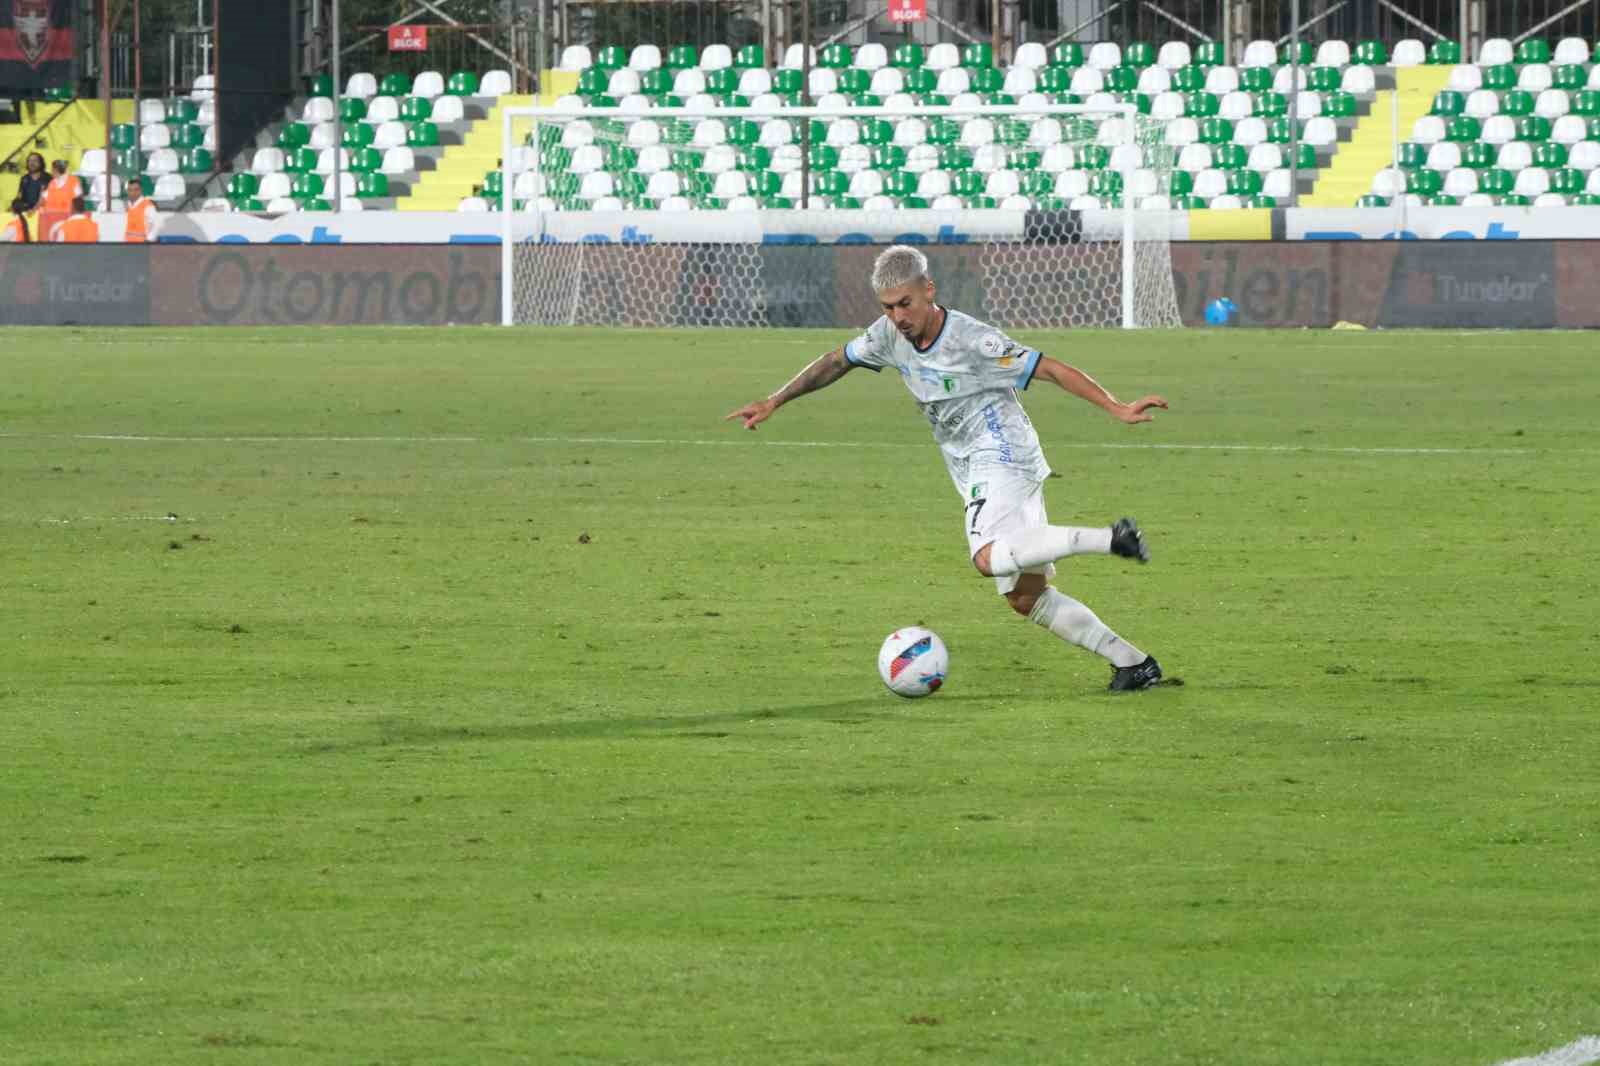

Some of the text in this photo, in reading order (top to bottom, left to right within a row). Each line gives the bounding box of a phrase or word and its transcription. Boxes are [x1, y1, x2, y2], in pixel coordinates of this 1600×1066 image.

[893, 9, 921, 20] BLOK
[403, 26, 412, 38] A
[393, 38, 422, 49] BLOK
[964, 498, 987, 528] 7
